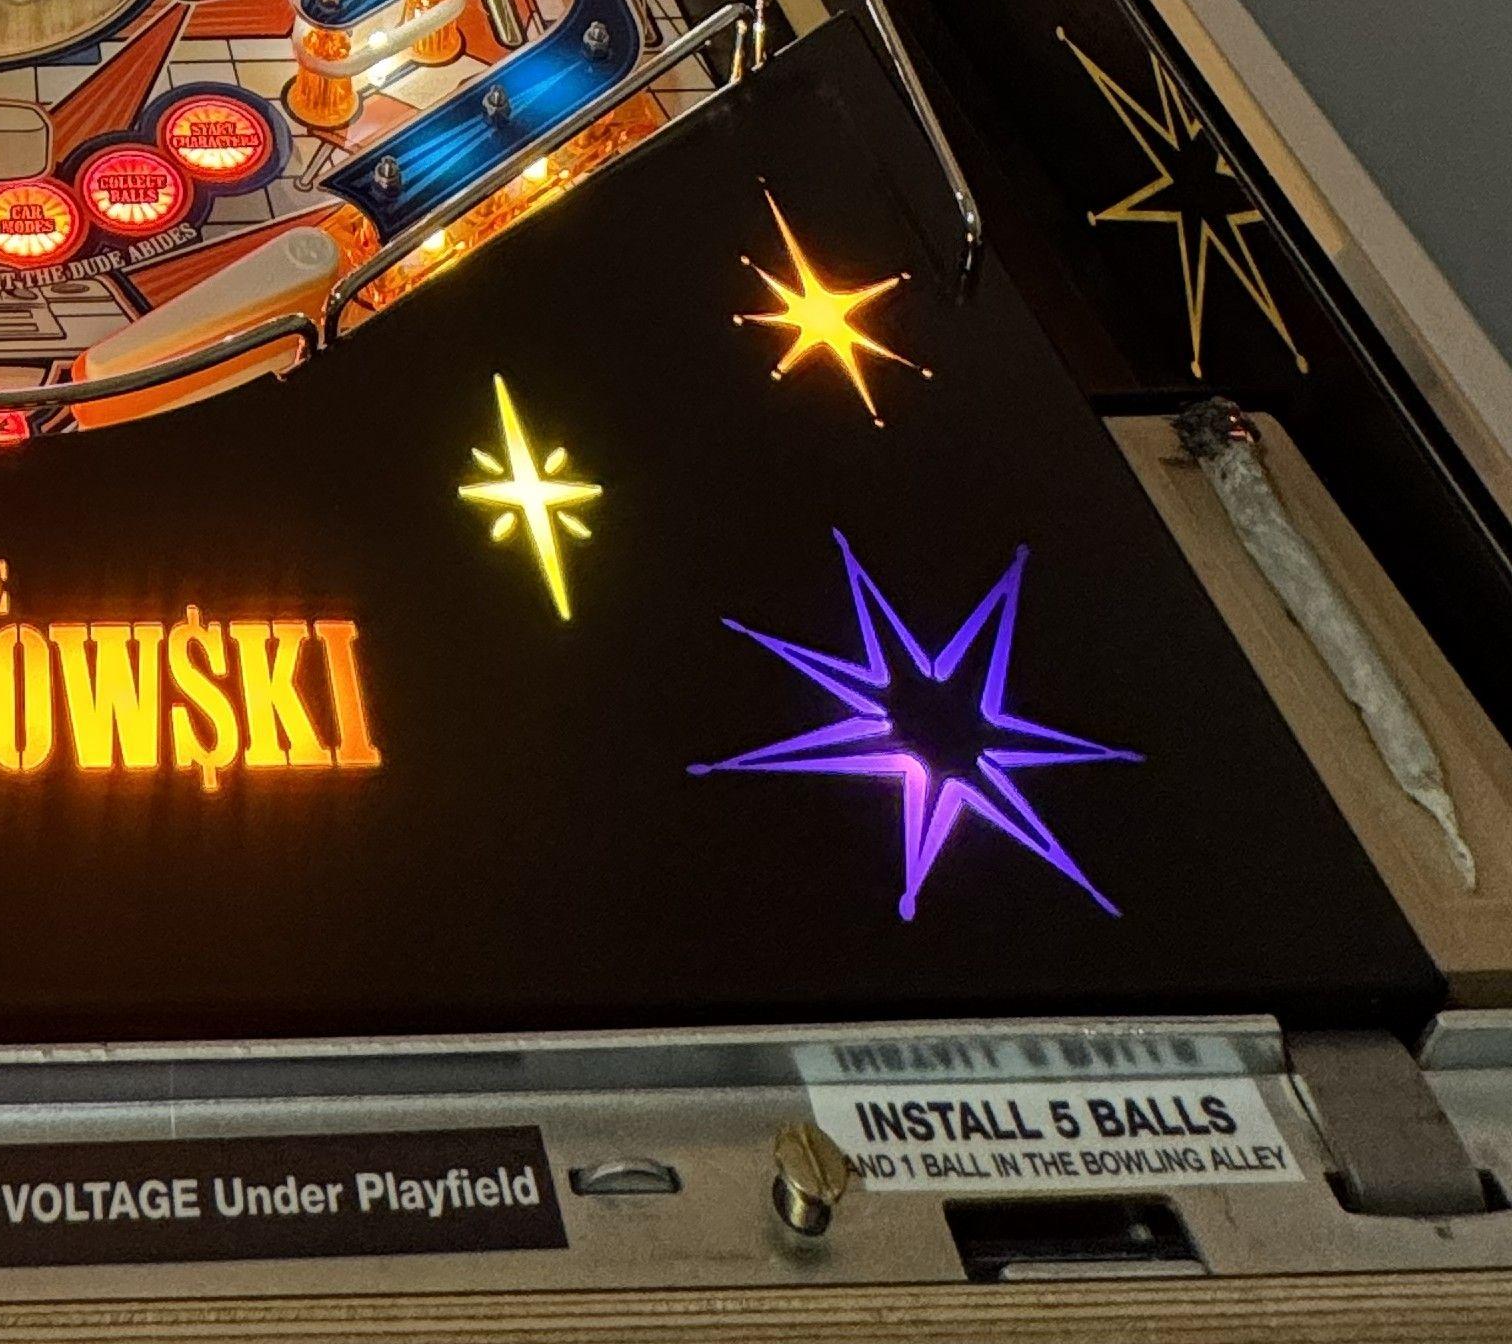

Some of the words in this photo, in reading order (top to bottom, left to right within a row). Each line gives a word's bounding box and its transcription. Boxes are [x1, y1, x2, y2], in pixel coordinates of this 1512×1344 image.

[190, 122, 236, 136] START
[98, 175, 167, 189] COLLECT
[110, 189, 158, 203] BALLS
[11, 206, 44, 220] CAR
[0, 219, 55, 234] MODES
[21, 265, 66, 290] THE
[68, 246, 126, 282] DUDE
[128, 222, 199, 265] ABIDES
[855, 1100, 1044, 1142] INSTALL
[1048, 1100, 1081, 1140] 5
[1088, 1096, 1238, 1137] BALLS
[843, 1153, 896, 1179] AND
[900, 1154, 916, 1179] 1
[921, 1151, 992, 1179] BALL
[995, 1151, 1022, 1178] IN
[1025, 1150, 1079, 1177] THE
[1083, 1148, 1206, 1176] BOWLING
[1208, 1145, 1288, 1173] ALLEY
[1, 1178, 201, 1223] VOLTAGE
[213, 1174, 344, 1216] Under
[355, 1166, 542, 1218] Playfield
